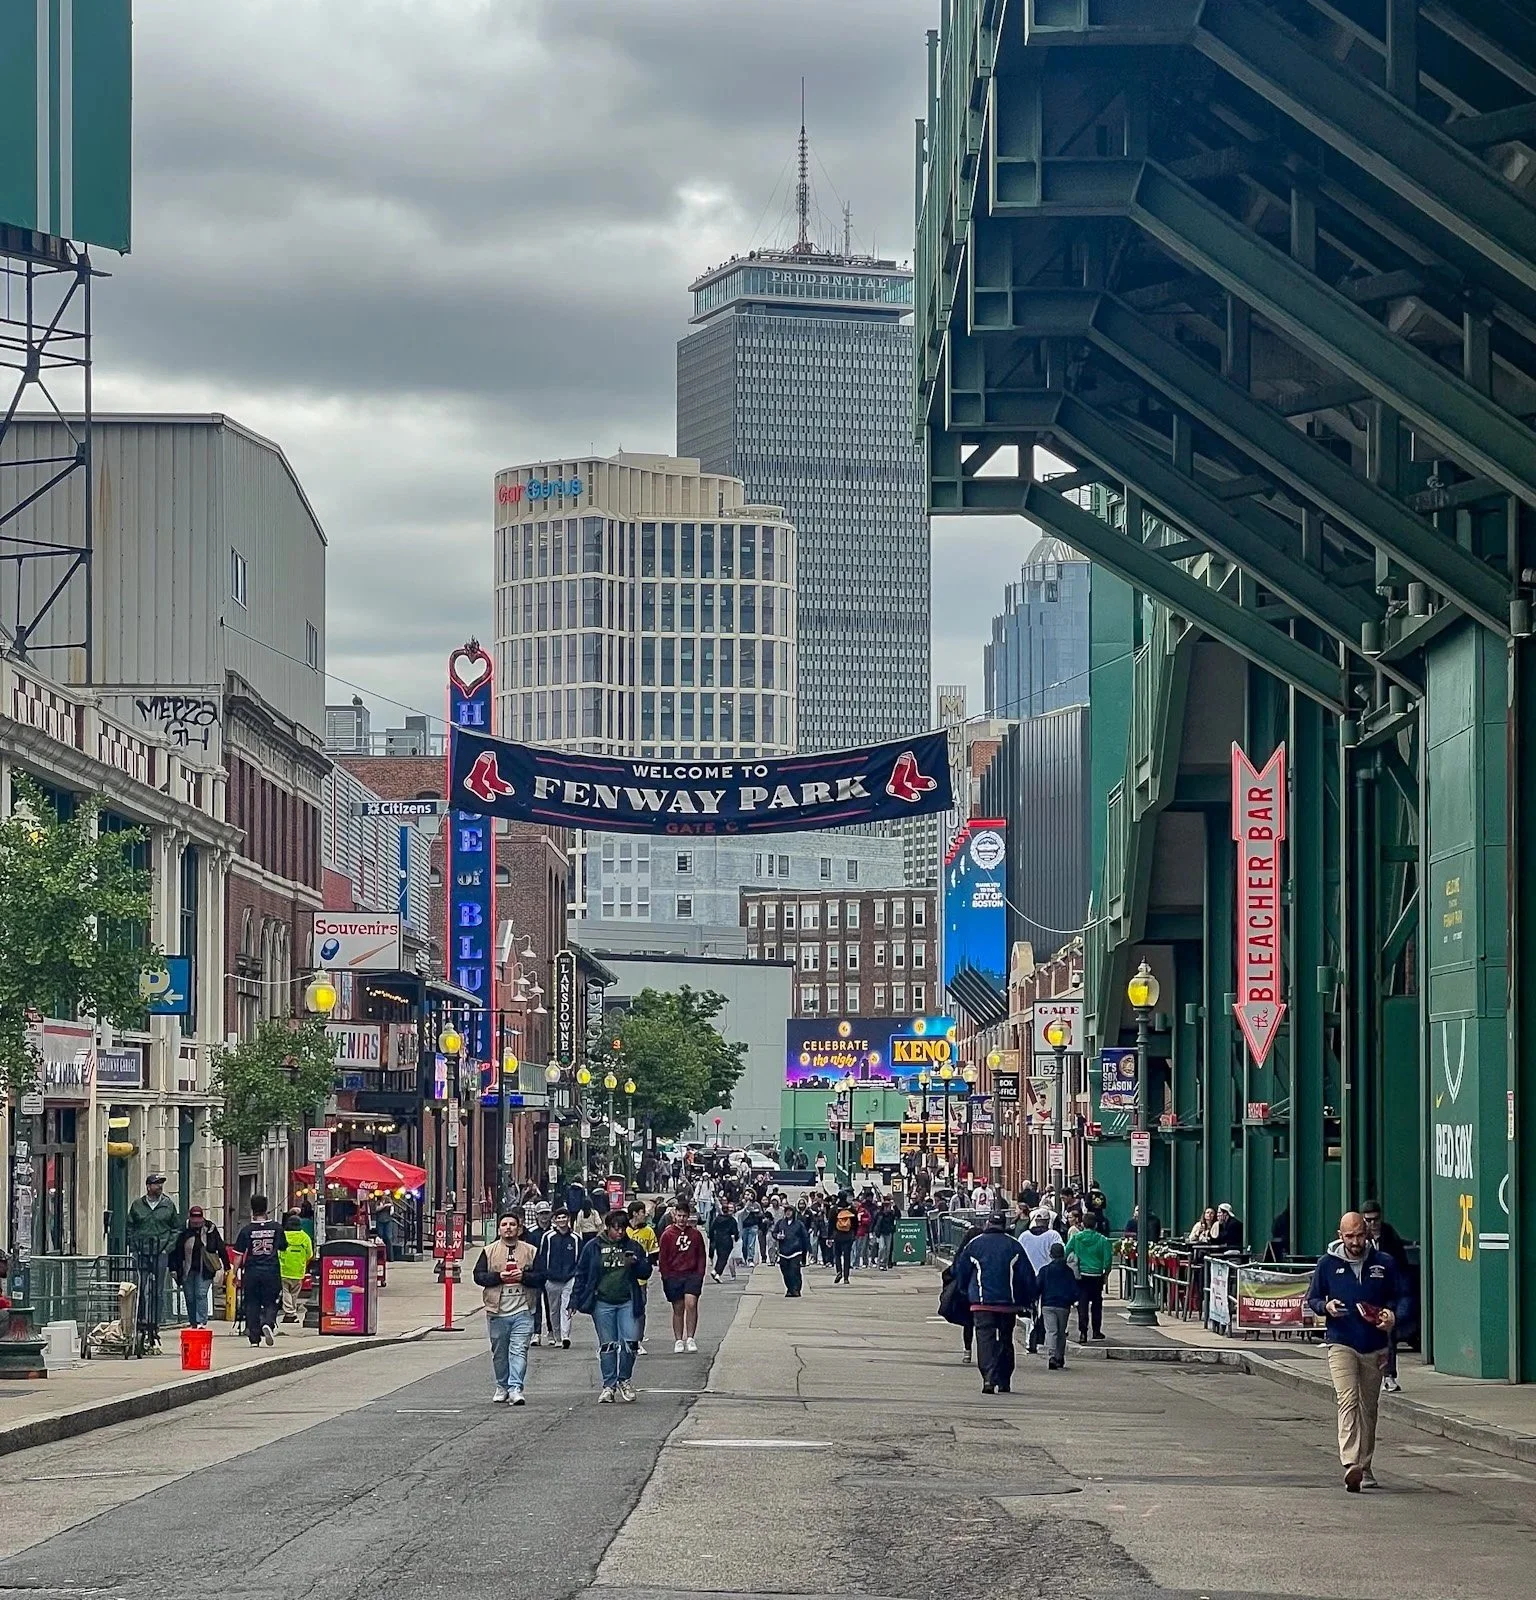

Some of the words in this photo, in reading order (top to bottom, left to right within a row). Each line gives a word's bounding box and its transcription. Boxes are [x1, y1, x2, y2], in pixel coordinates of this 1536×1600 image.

[771, 271, 888, 289] PRUDENTIAL
[632, 764, 733, 779] WELCOME
[741, 764, 768, 778] TO
[533, 775, 726, 814] FENWAY
[738, 775, 871, 811] PARK
[380, 802, 432, 816] Citizens
[1248, 786, 1274, 840] BAR
[665, 822, 716, 834] GATE
[973, 892, 990, 900] CITY
[991, 892, 1003, 900] OF
[972, 900, 1004, 908] BOSTON
[315, 920, 398, 935] Souvenirs
[1248, 856, 1274, 1002] BLEACHER
[559, 964, 571, 1051] LANSDOWNE
[1038, 1006, 1080, 1015] GATE
[803, 1040, 869, 1051] CELEBRATE
[893, 1040, 951, 1062] KENO
[813, 1053, 828, 1067] the
[830, 1052, 857, 1068] night
[1043, 1065, 1056, 1075] 52
[1103, 1062, 1117, 1073] IT'S
[1103, 1072, 1118, 1082] SOX
[1102, 1081, 1132, 1091] SEASON
[1435, 1123, 1454, 1178] RED
[1454, 1123, 1474, 1180] SOX
[1459, 1193, 1474, 1262] 25
[1242, 1297, 1255, 1306] THIS
[1255, 1298, 1275, 1308] BUD'S
[1276, 1298, 1288, 1307] FOR
[1288, 1298, 1302, 1307] YOU
